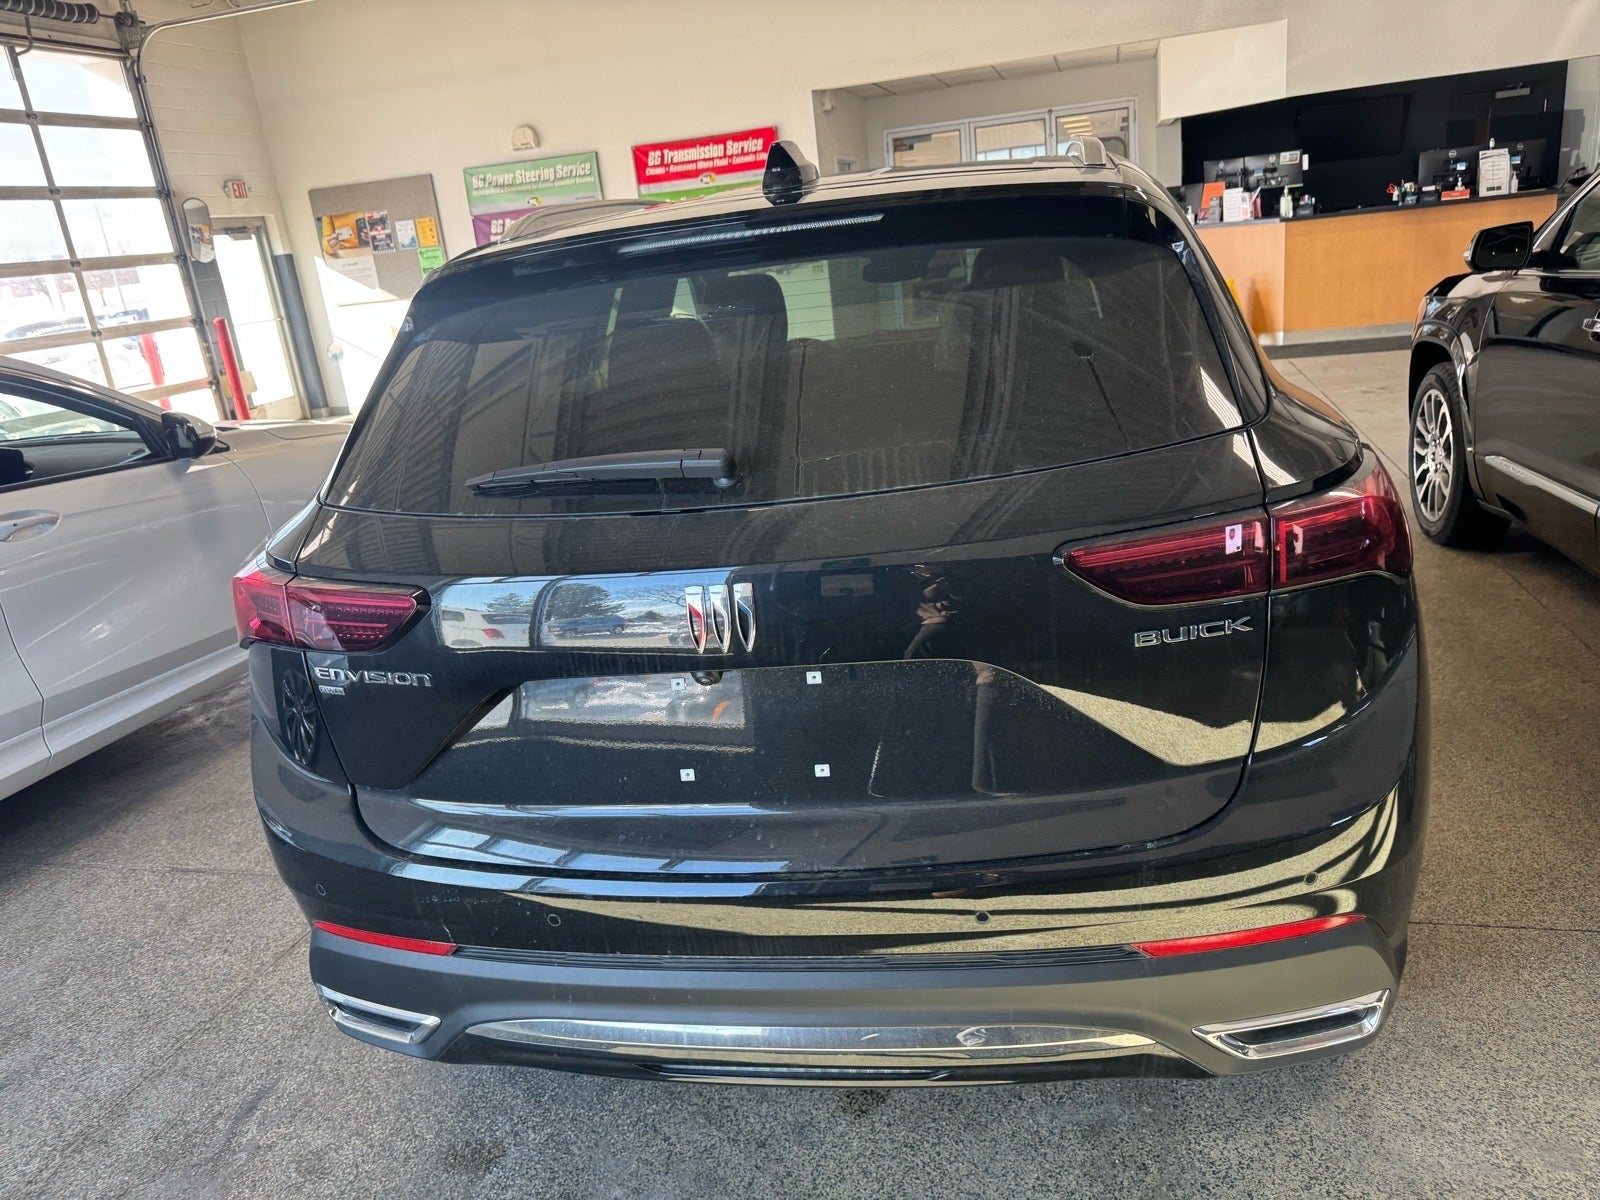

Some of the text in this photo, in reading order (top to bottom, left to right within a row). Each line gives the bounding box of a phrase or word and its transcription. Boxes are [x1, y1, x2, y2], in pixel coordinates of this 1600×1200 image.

[648, 137, 764, 167] BG Transmission Service
[472, 174, 486, 190] BG
[486, 172, 514, 187] Power
[515, 167, 555, 184] Steering
[556, 162, 591, 179] Service
[231, 182, 249, 199] EXIT
[490, 219, 504, 234] BG
[1134, 616, 1254, 647] BUICK
[314, 667, 433, 687] ENVISION
